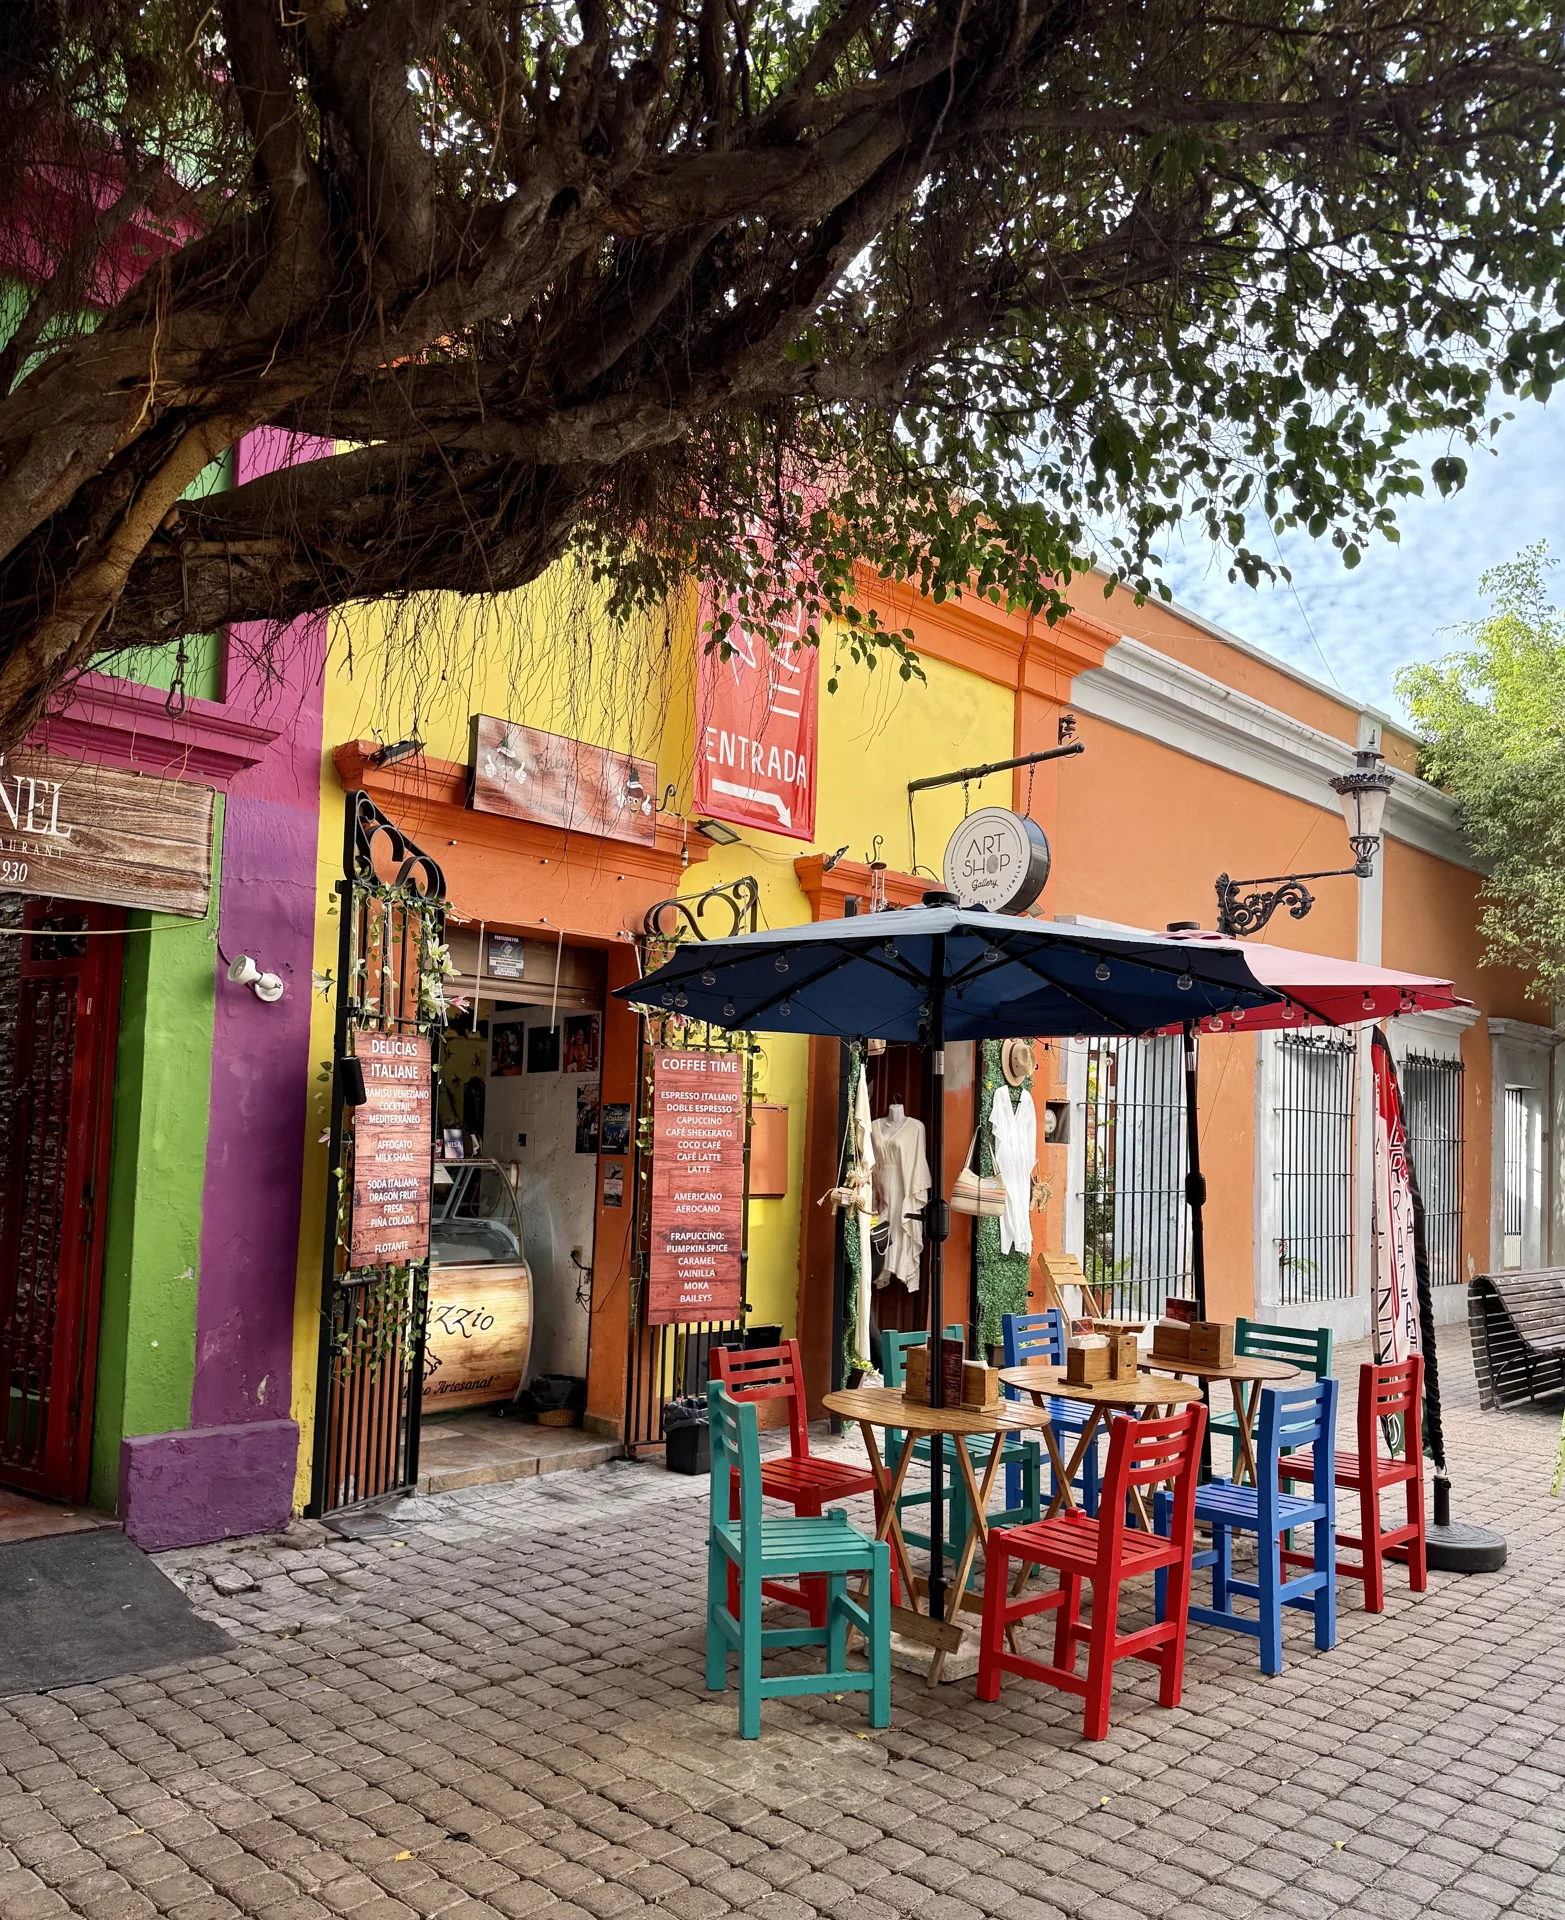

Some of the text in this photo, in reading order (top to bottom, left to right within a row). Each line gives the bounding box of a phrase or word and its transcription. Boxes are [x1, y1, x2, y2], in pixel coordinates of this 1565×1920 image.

[705, 726, 807, 789] ENTRADA
[966, 832, 1006, 858] ART
[962, 853, 1011, 878] SHOP
[950, 866, 967, 899] HANDMADE
[1006, 860, 1023, 892] JEWELRY
[972, 878, 999, 891] Gallery
[371, 1039, 418, 1056] DELICIAS
[661, 1058, 738, 1073] COFFEE TIME
[371, 1063, 419, 1079] ITALIANE
[365, 1086, 429, 1099] RAMISÚ VENEZIANO
[661, 1091, 738, 1102] ESPRESSO ITALIANO
[379, 1101, 411, 1111] COCKTAIL
[666, 1104, 732, 1113] DOBLE ESPRESSO
[676, 1116, 723, 1125] CAPUCCINO
[665, 1127, 733, 1137] CAFÉ SHEKERATO
[377, 1140, 412, 1150] AFFOGATO
[677, 1140, 722, 1149] COCO CAFÉ
[375, 1152, 414, 1163] MILK SHAKE
[676, 1152, 722, 1161] CAFÉ LATTE
[687, 1165, 711, 1174] LATTE
[367, 1177, 419, 1189] SODA ITALIANA:
[369, 1190, 418, 1202] DRAGON FRUIT
[673, 1192, 723, 1201] AMERICANO
[383, 1204, 403, 1214] FRESA
[675, 1205, 721, 1213] AEROCANO
[370, 1215, 415, 1228] PIÑA COLADA
[670, 1232, 725, 1241] FRAPUCCINO:
[374, 1241, 409, 1254] FLOTANTE
[666, 1244, 728, 1253] PUMPKIN SPICE
[678, 1257, 716, 1266] CARAMEL
[678, 1269, 716, 1278] VAINILLA
[683, 1281, 709, 1290] MOKA
[680, 1294, 712, 1303] BAILEYS
[433, 1375, 494, 1395] Artesanal
